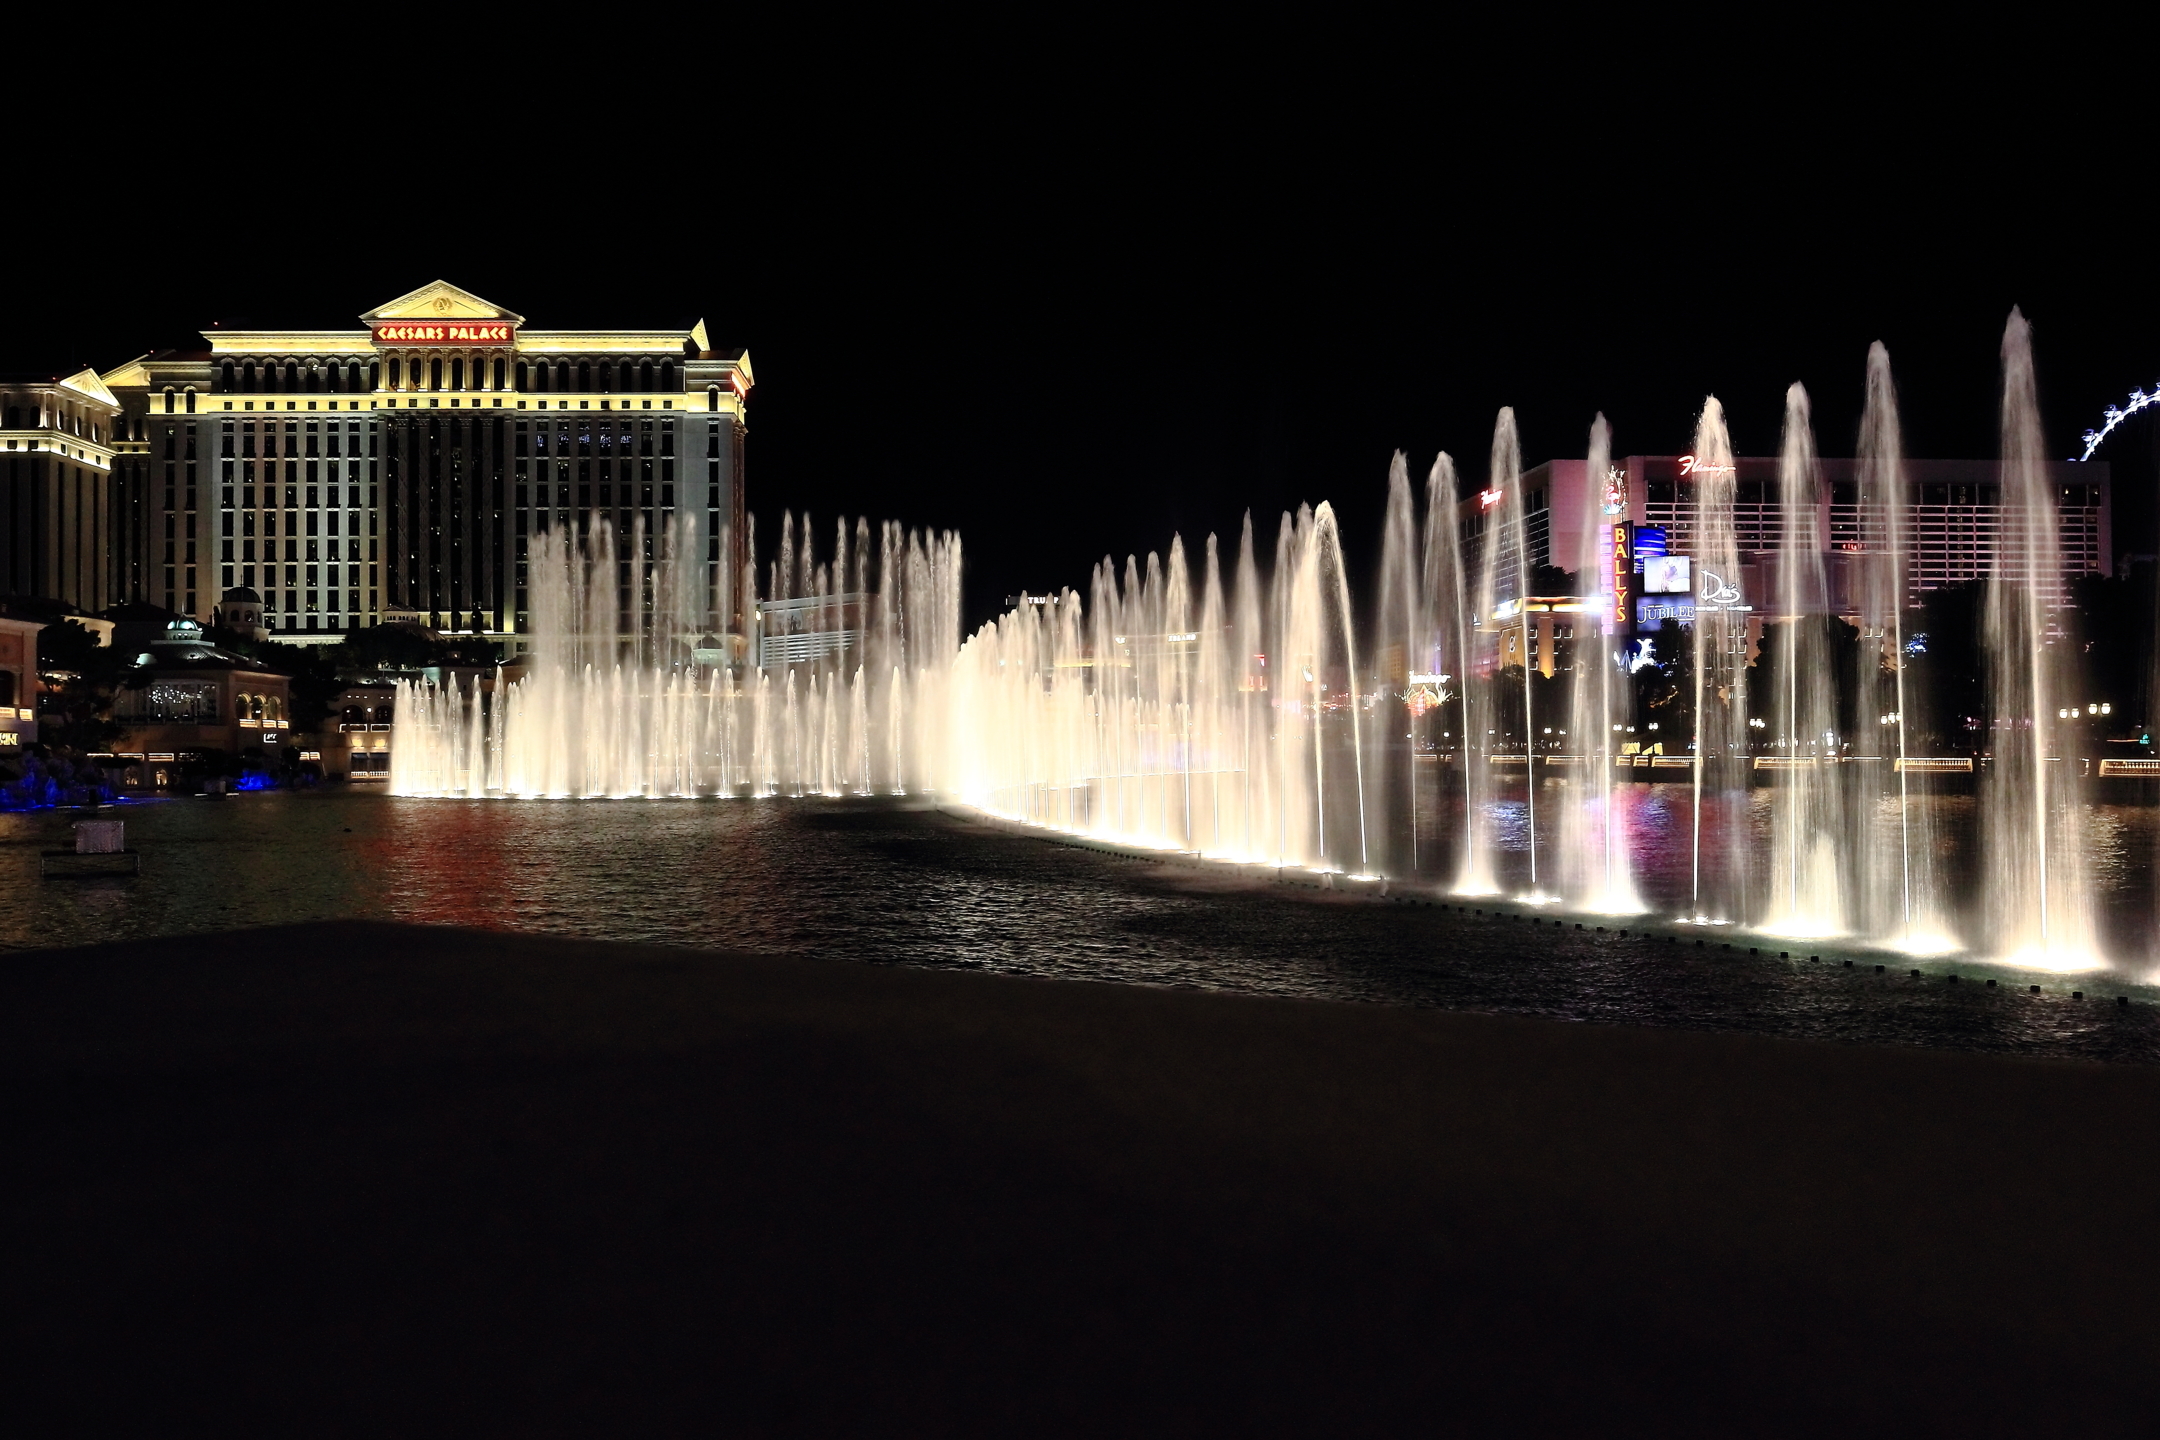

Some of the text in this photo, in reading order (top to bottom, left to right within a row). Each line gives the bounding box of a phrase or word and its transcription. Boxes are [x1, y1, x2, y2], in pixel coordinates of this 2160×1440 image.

[377, 327, 508, 340] CAESARS PALACE
[1678, 455, 1736, 477] Flamingo
[1027, 596, 1060, 604] TRUP
[1637, 605, 1696, 624] JUBILEE
